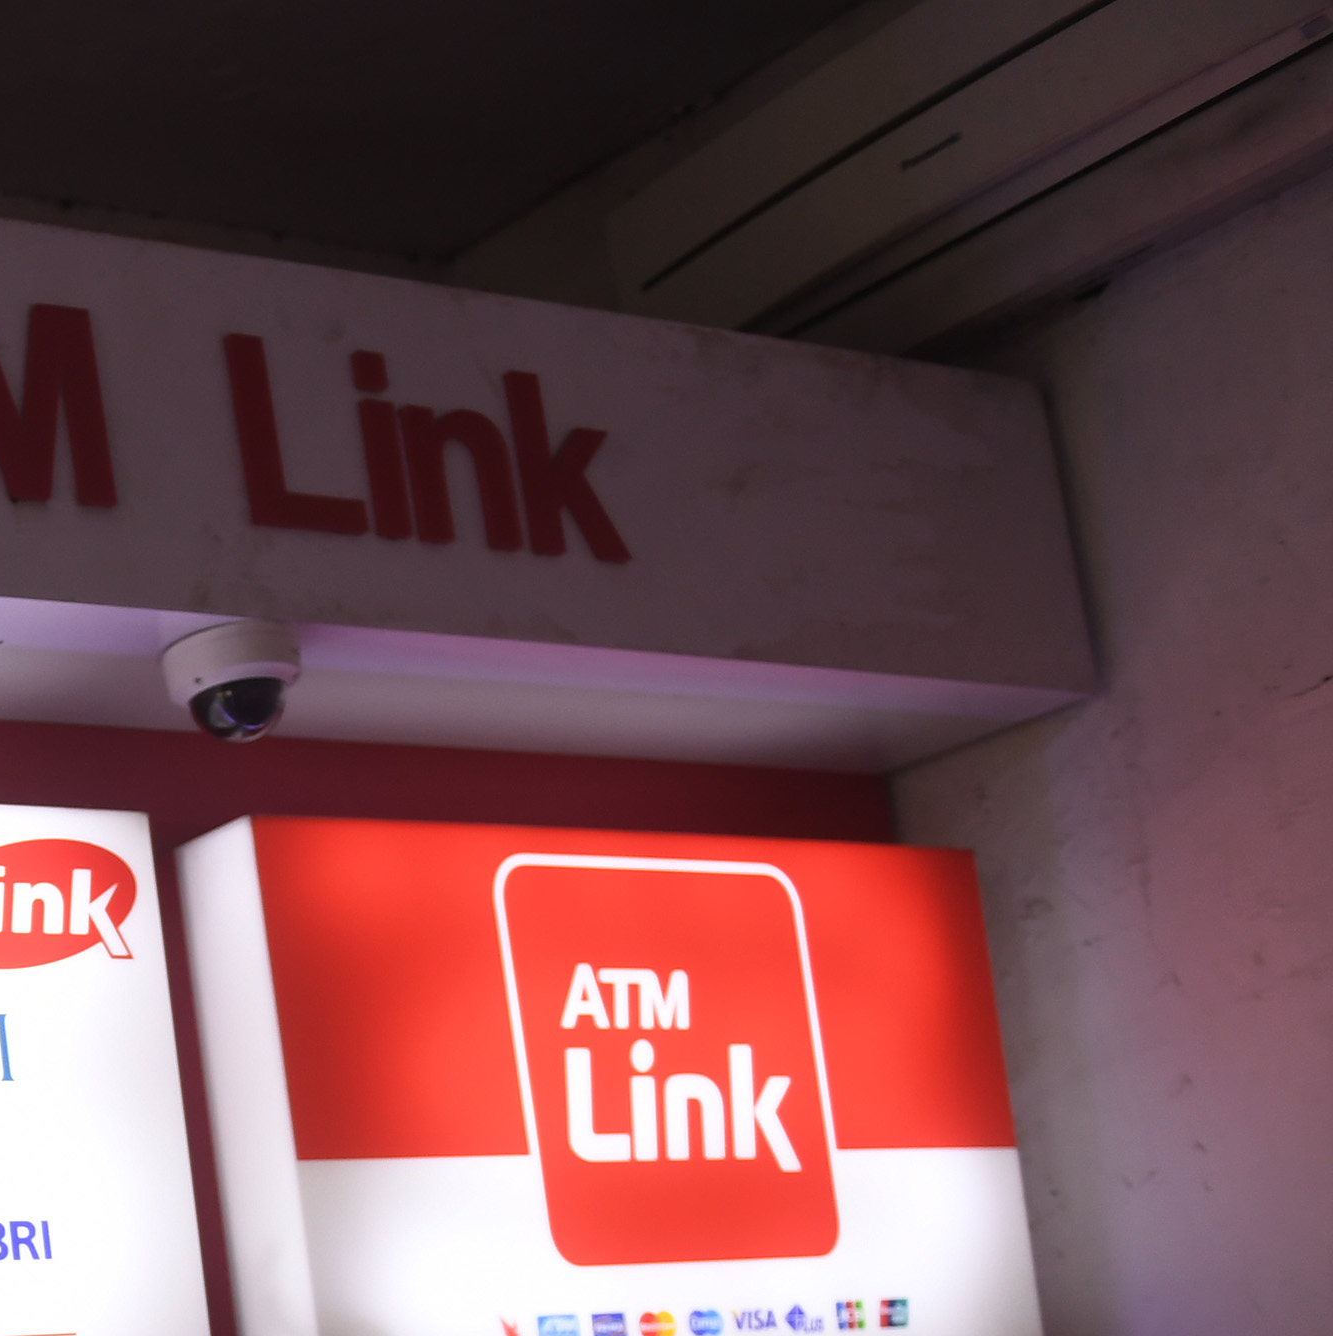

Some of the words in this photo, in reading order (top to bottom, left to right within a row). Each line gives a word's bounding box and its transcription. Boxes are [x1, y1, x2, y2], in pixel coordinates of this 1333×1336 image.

[223, 332, 632, 564] Link
[560, 962, 691, 1030] ATM
[564, 1038, 803, 1173] Link
[731, 1310, 778, 1331] VISA
